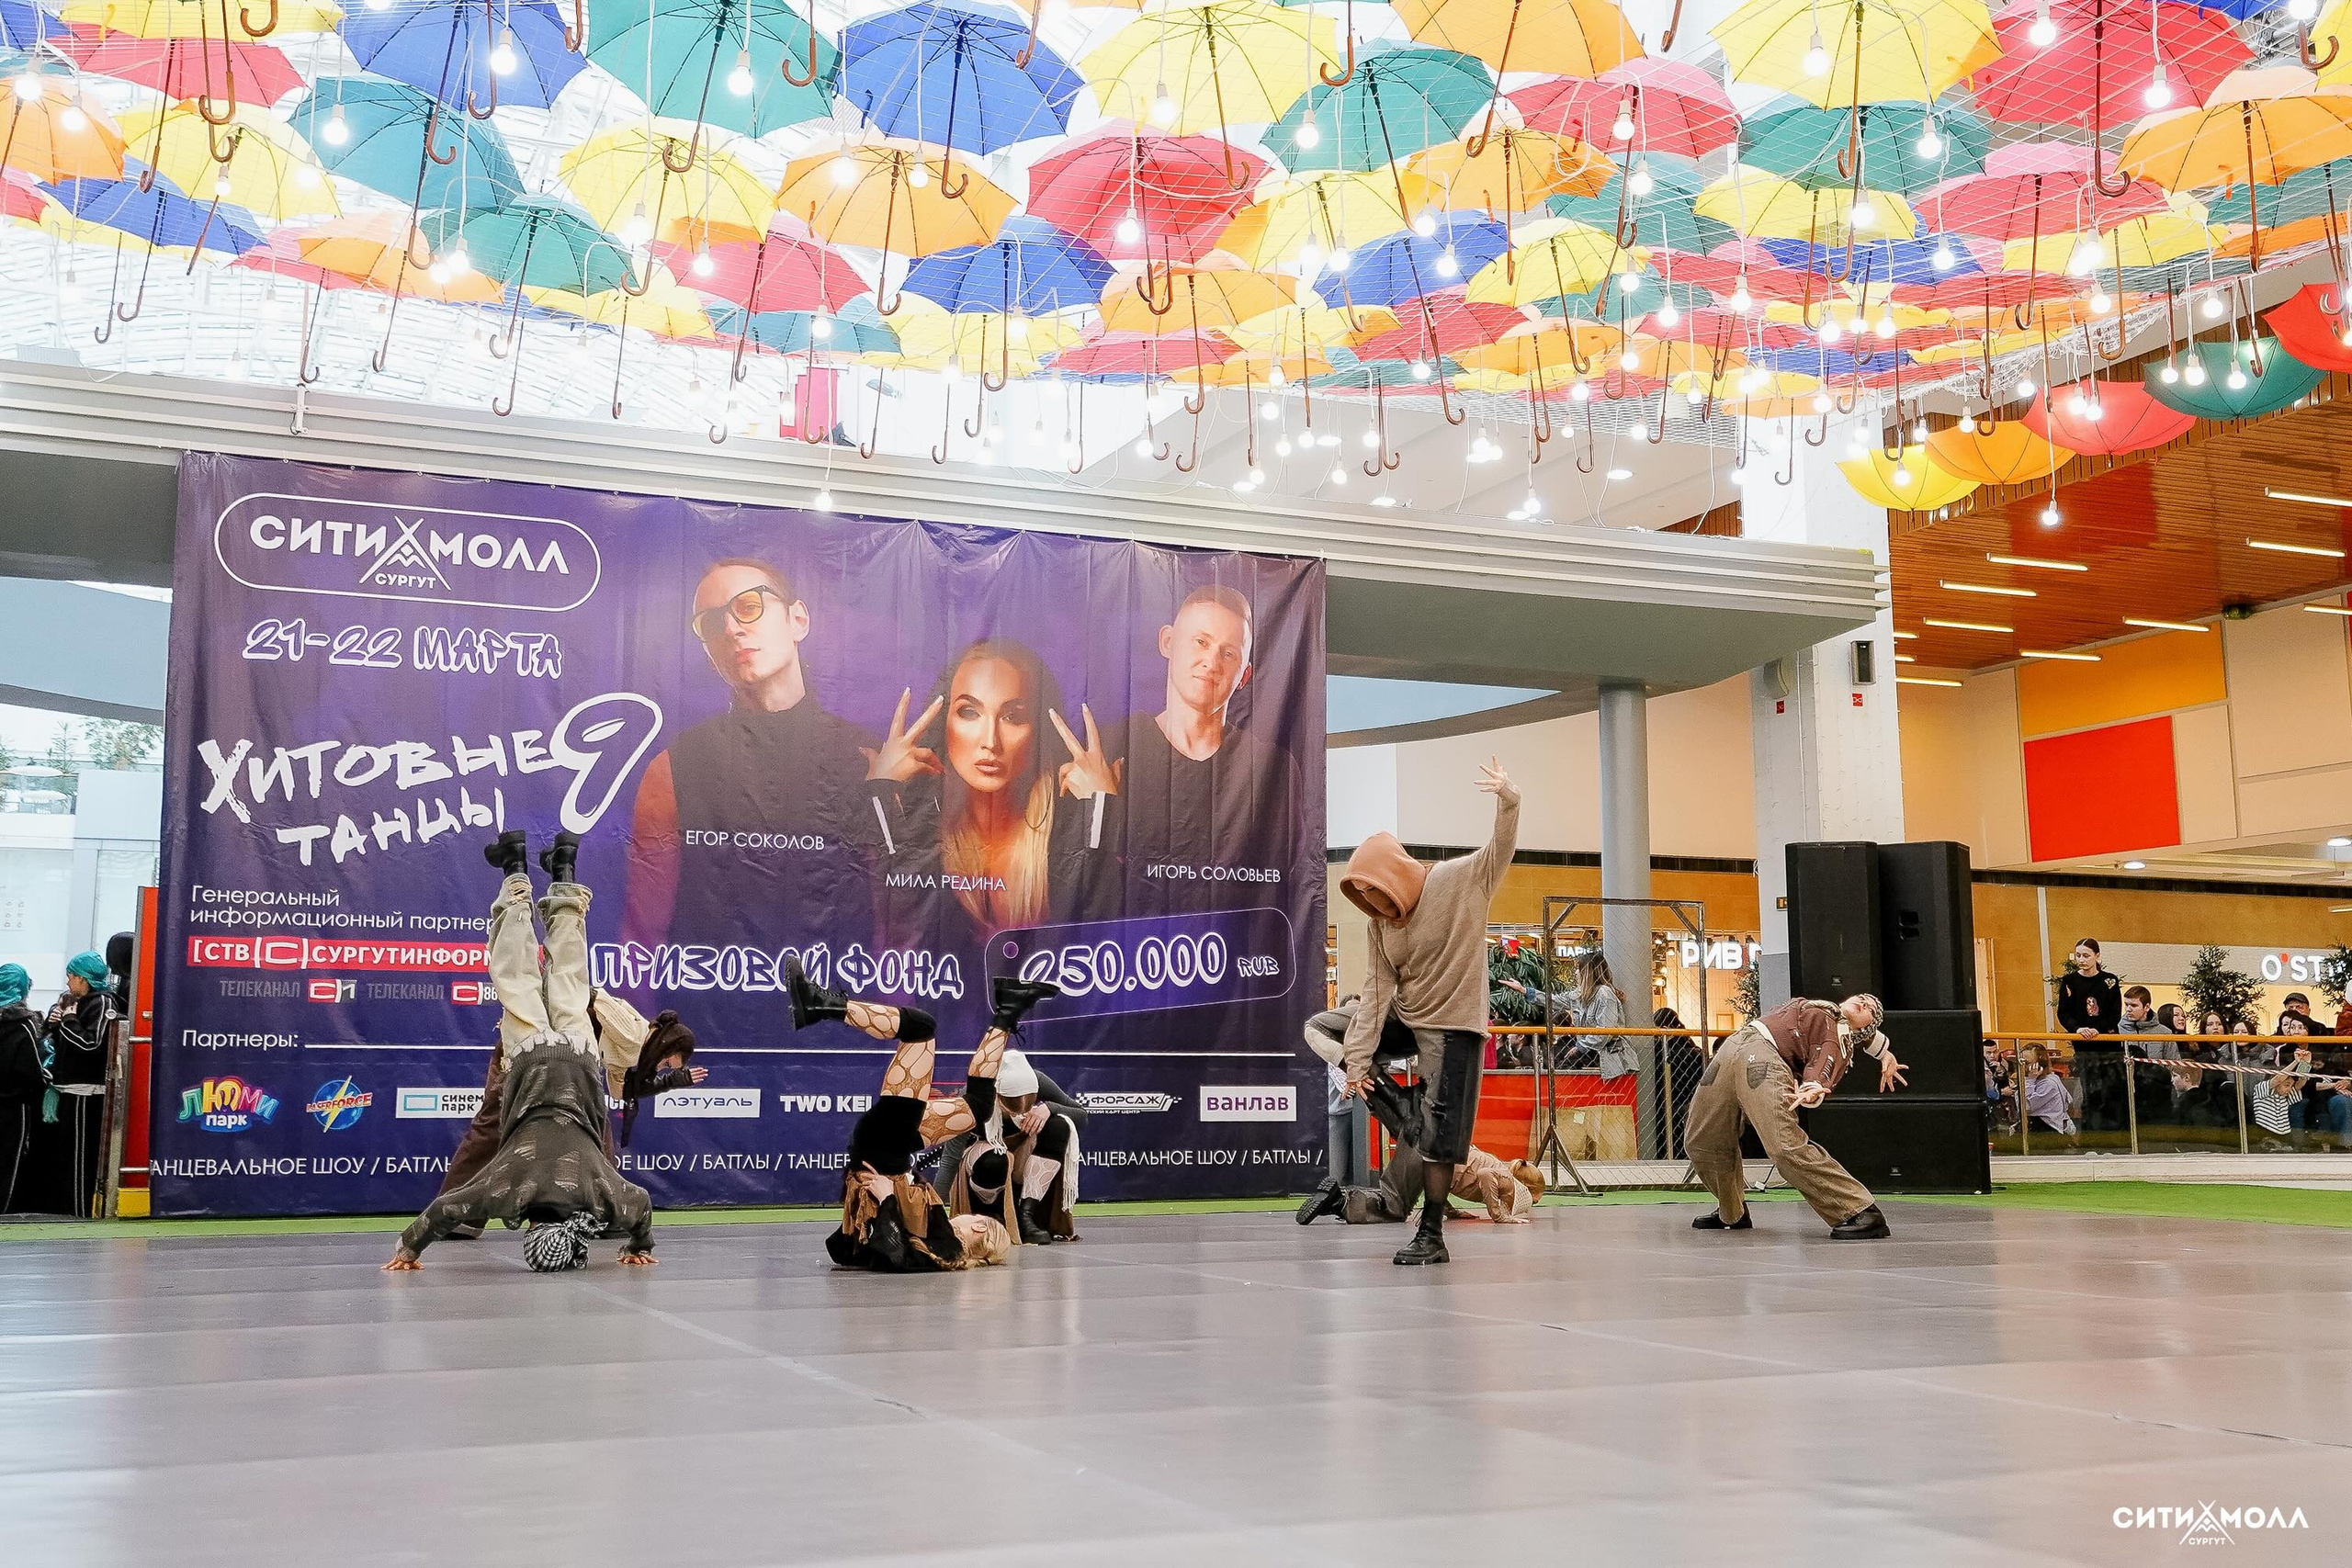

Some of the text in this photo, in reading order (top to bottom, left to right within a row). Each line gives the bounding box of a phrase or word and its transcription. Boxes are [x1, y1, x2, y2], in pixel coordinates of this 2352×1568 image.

[250, 514, 570, 575] СИТИ МОЛЛ
[374, 572, 436, 590] СУРГУТ
[242, 618, 563, 680] 21-22 МАРТА
[276, 786, 504, 866] ТАНЦЫ
[685, 829, 825, 851] ЕГОР СОКОЛОВ
[885, 873, 1006, 892] МИЛА РЕДИНА
[1148, 863, 1281, 883] ИГОРЬ СОЛОВЬЕВ
[191, 885, 340, 907] Генеральный
[190, 907, 403, 930] информационный
[1019, 931, 1280, 997] 250.000 RUB
[220, 980, 300, 998] ТЕЛЕКАНАЛ
[368, 982, 445, 1001] ТЕЛЕКАНАЛ
[183, 1030, 299, 1051] Партнеры:
[441, 1103, 475, 1114] парк
[442, 1094, 484, 1103] синем
[779, 1095, 831, 1112] TWO
[1091, 1096, 1160, 1105] ФОРСАЖ
[1206, 1096, 1290, 1111] ванлав
[150, 1157, 307, 1179] АНЦЕВАЛЬНОЕ
[312, 1156, 365, 1175] ШОУ
[637, 1155, 684, 1171] ШОУ
[703, 1154, 770, 1170] БАТТЛЫ
[1078, 1151, 1193, 1168] АНЦЕВАЛЬНОЕ
[1197, 1150, 1238, 1166] ШОУ
[1252, 1149, 1311, 1165] БАТТЛЫ
